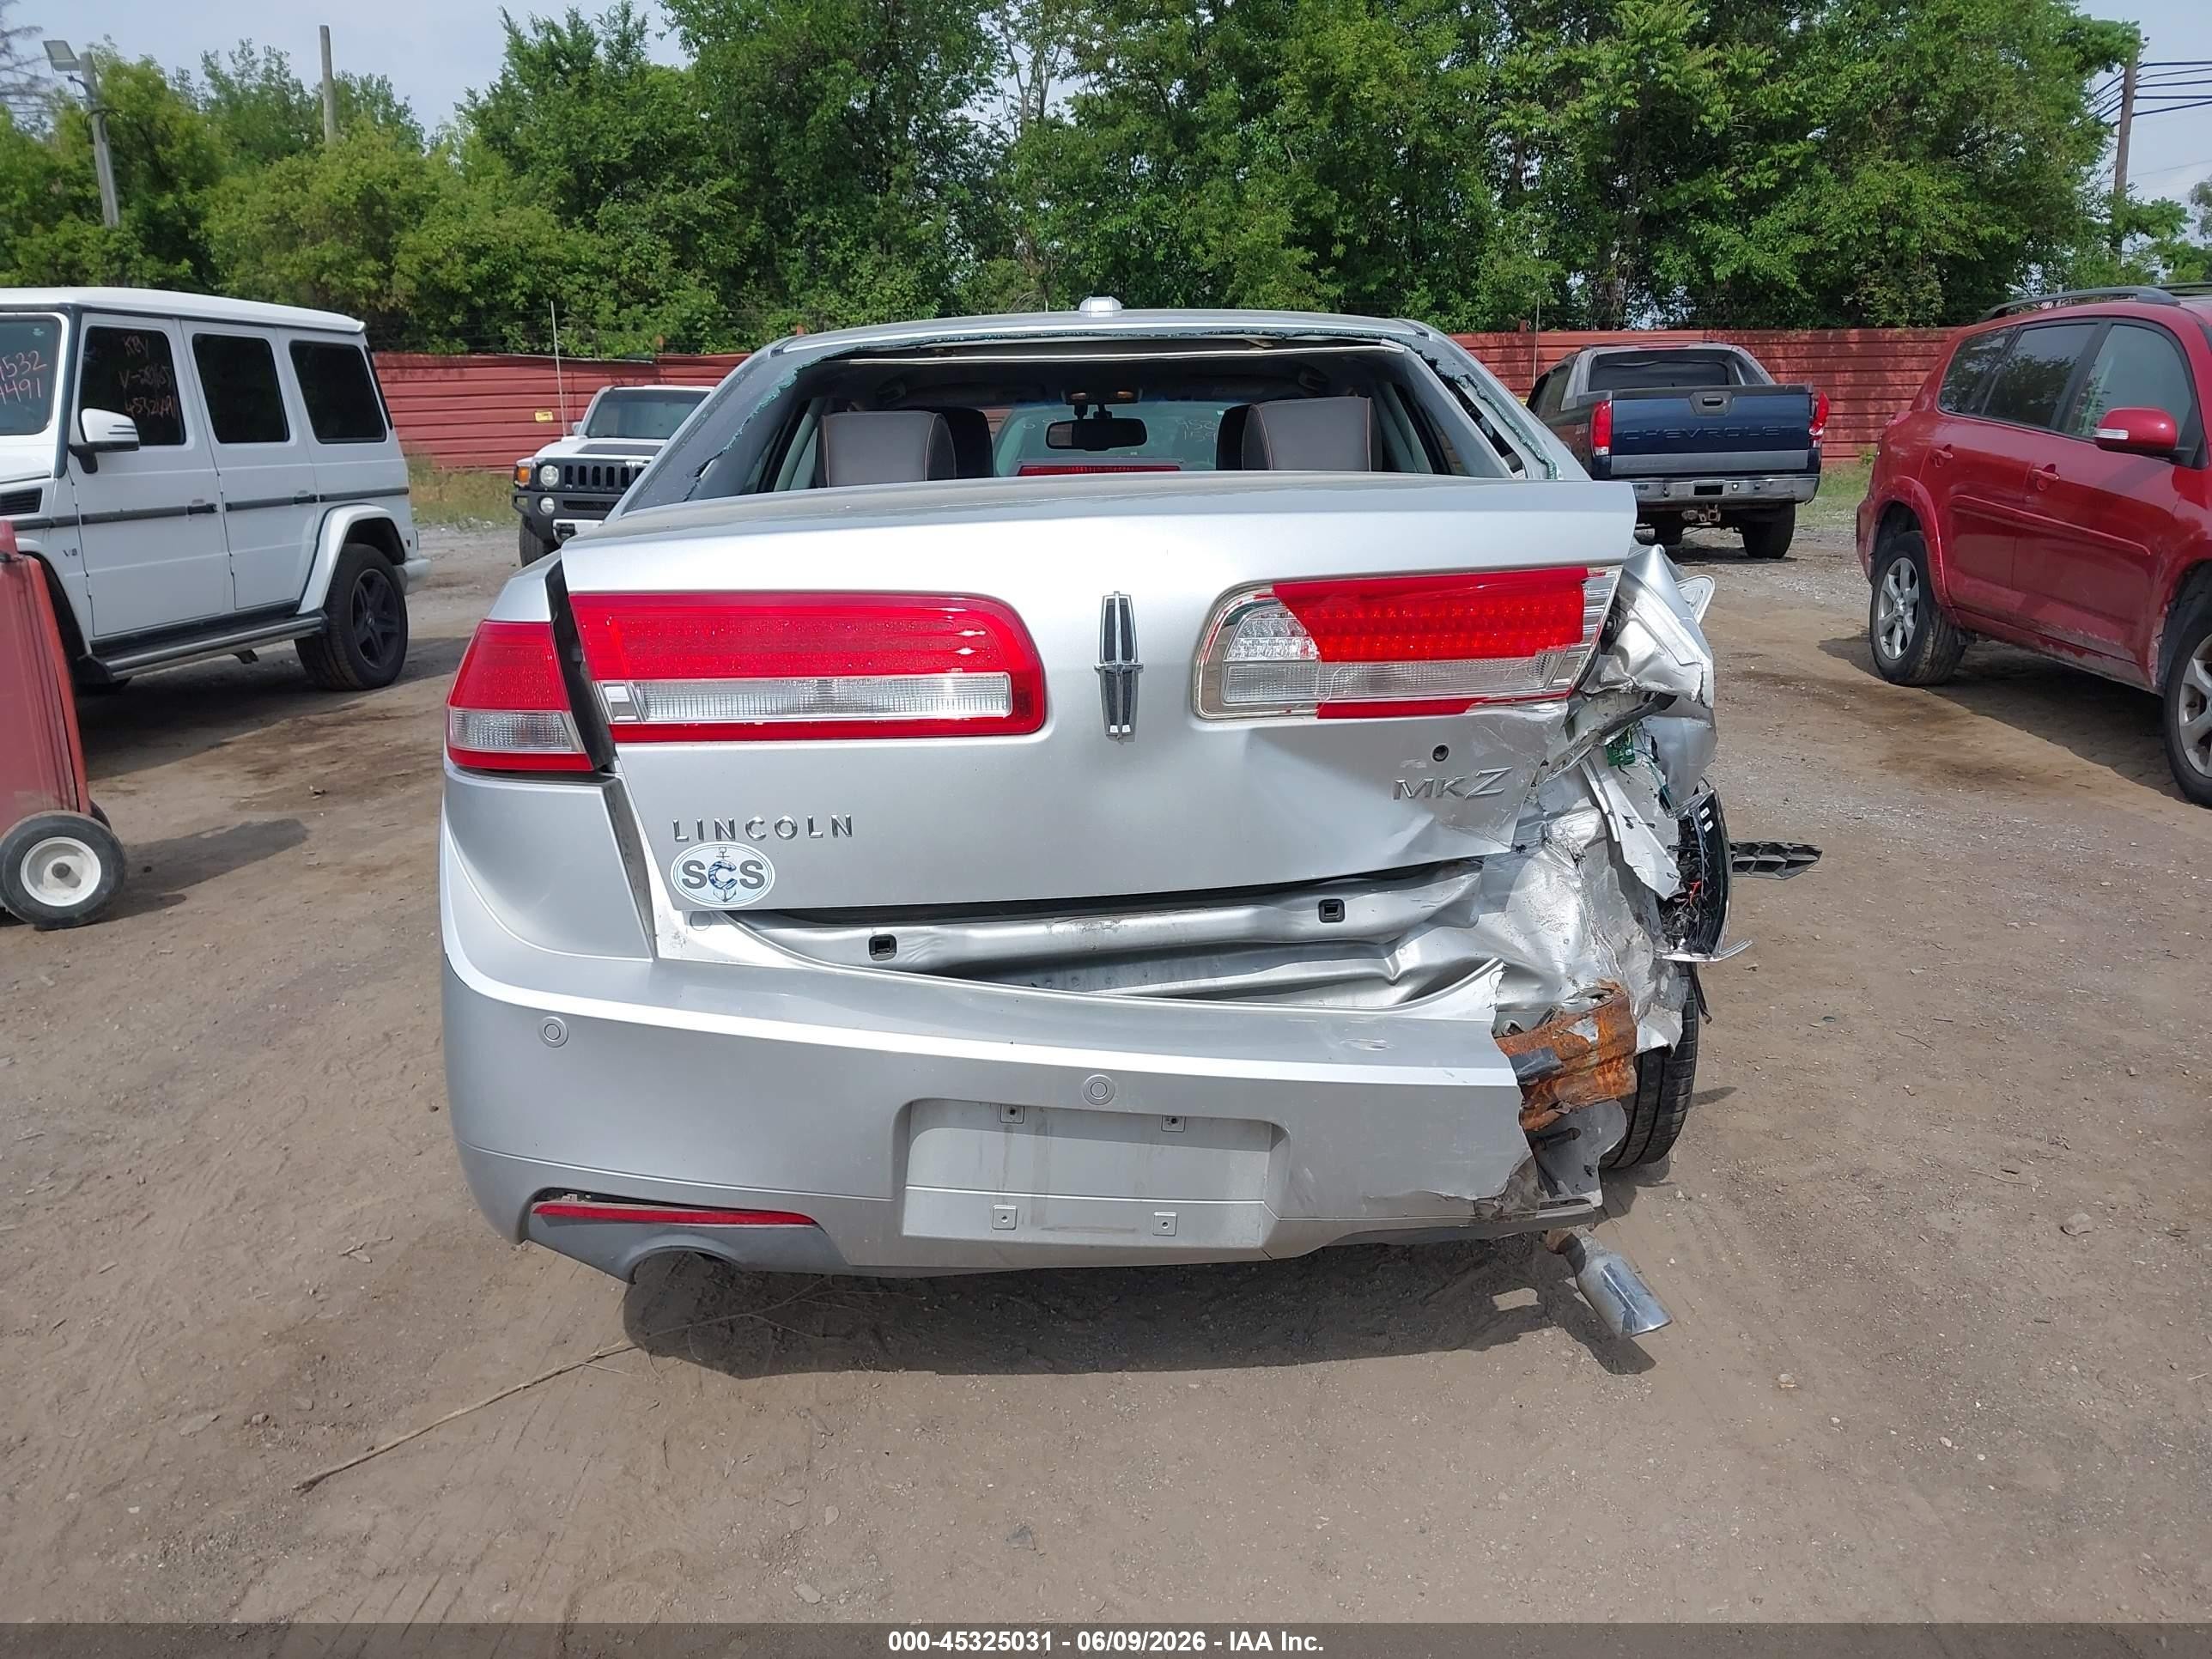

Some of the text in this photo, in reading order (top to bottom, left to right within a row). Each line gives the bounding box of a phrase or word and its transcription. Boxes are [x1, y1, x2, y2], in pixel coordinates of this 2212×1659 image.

[1622, 425, 1802, 441] CHEVROLET
[1393, 766, 1514, 799] MKZ
[673, 814, 853, 842] LINCOLN
[682, 860, 765, 890] SCS
